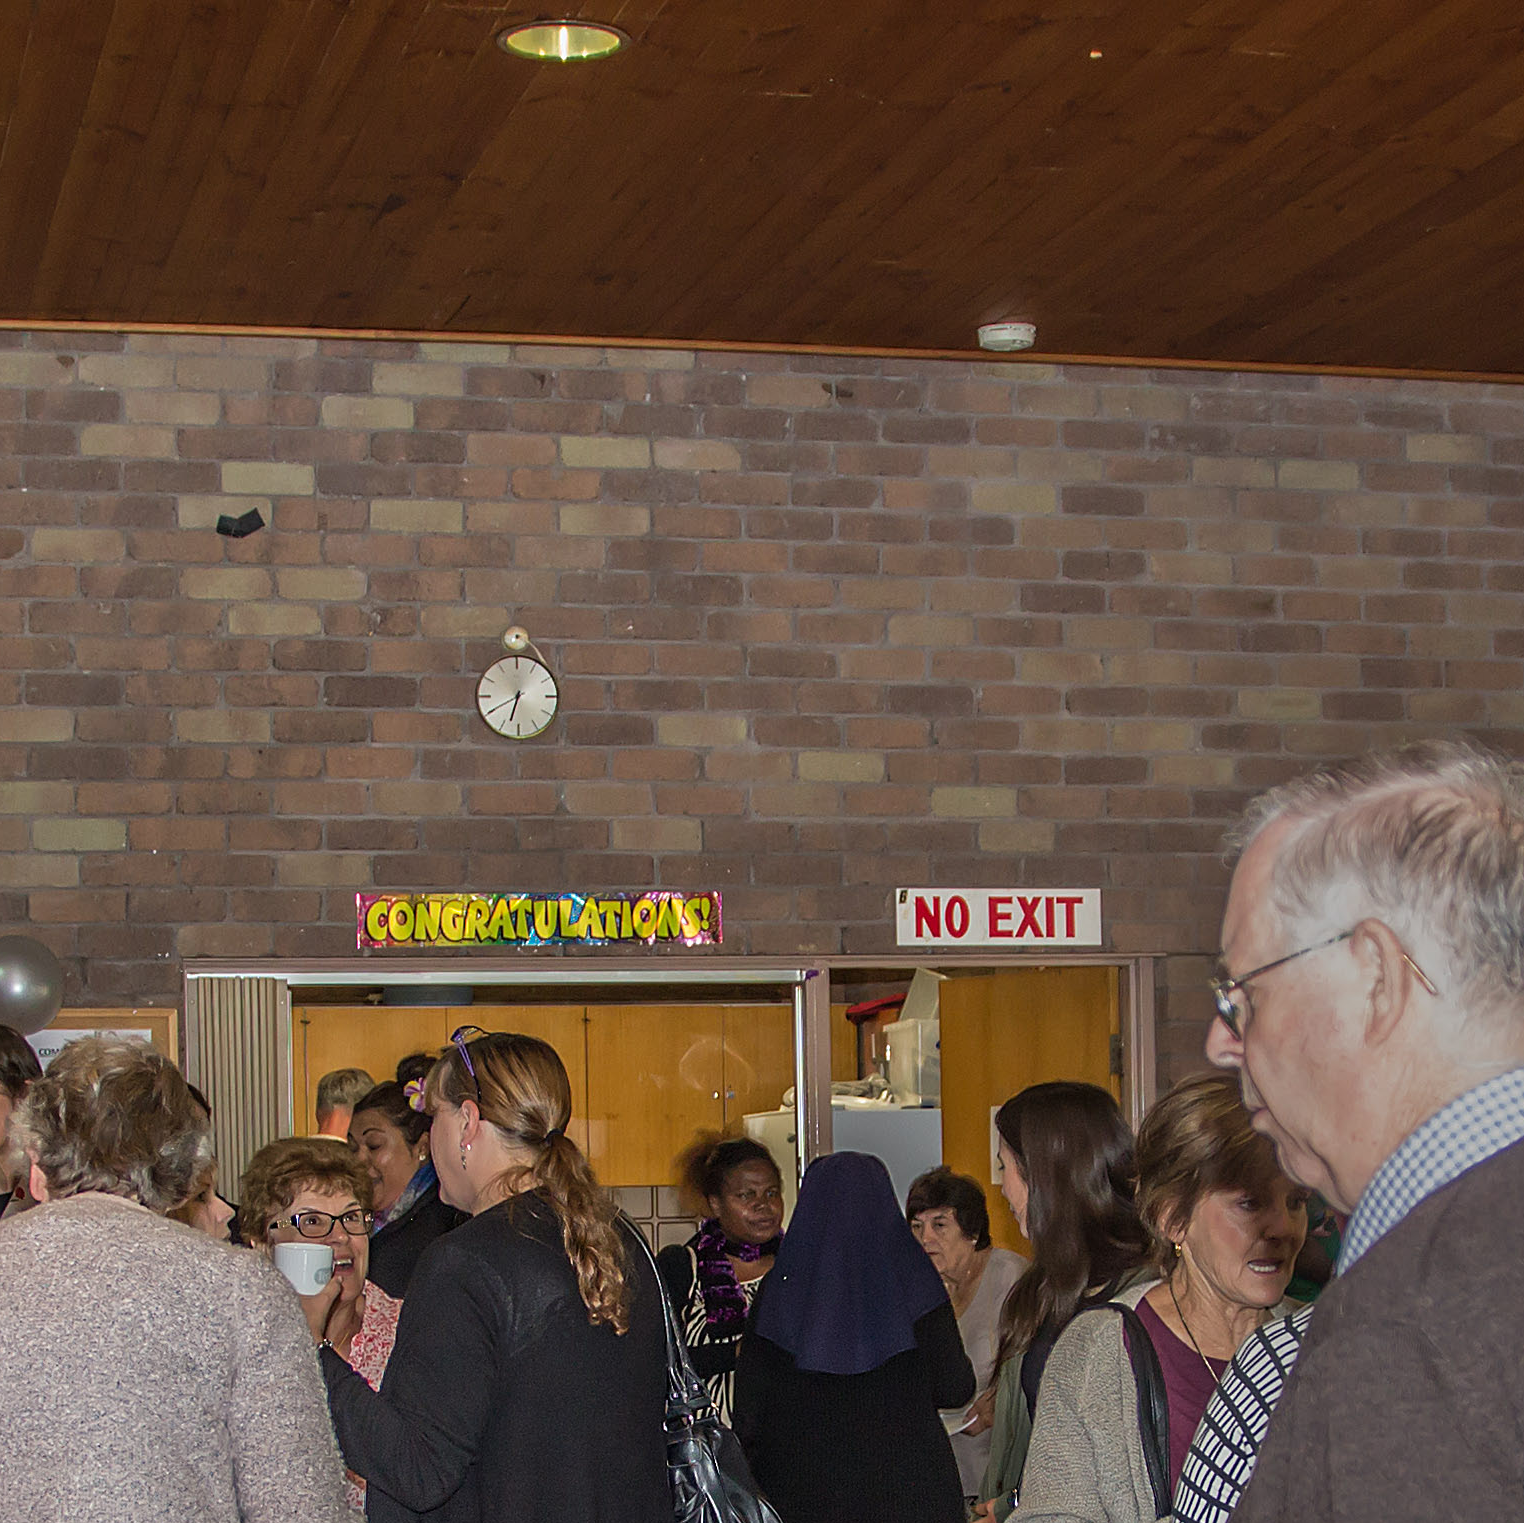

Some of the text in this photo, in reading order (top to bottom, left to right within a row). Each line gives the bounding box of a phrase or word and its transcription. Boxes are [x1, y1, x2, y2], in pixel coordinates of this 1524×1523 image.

[366, 896, 711, 942] CONGRATULATIONS!
[915, 895, 1084, 938] NO EXIT
